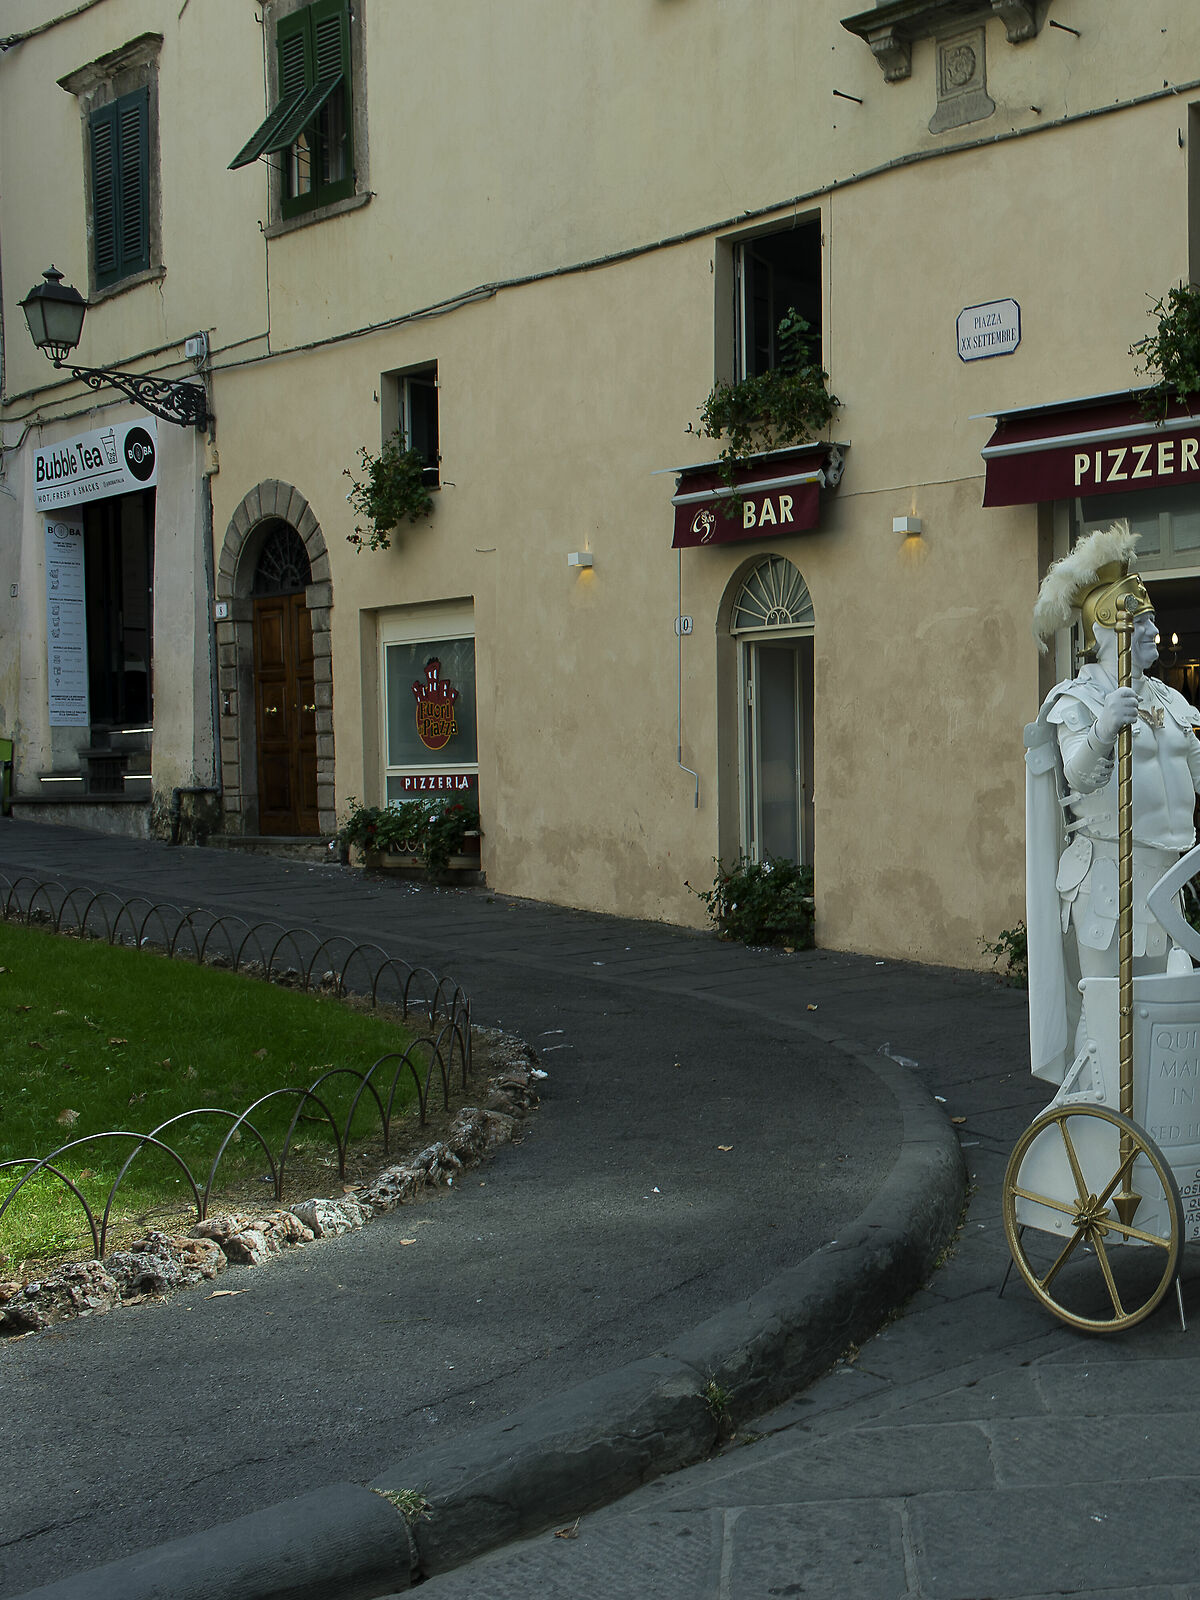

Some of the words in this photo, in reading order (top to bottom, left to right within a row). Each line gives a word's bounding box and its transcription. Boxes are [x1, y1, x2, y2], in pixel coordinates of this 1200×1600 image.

[974, 313, 1002, 329] PIAZZA
[961, 337, 971, 351] XX
[973, 328, 1016, 349] SETTEMBRE
[36, 448, 77, 482] Bubble
[75, 443, 104, 471] Tea
[53, 490, 70, 501] FRESH
[79, 482, 100, 495] SNACKS
[743, 494, 794, 529] BAR
[420, 700, 450, 719] Fuori
[423, 718, 458, 737] Piazza
[405, 776, 469, 789] PIZZERIA
[1157, 1030, 1197, 1055] QUI
[1173, 1086, 1195, 1105] IN
